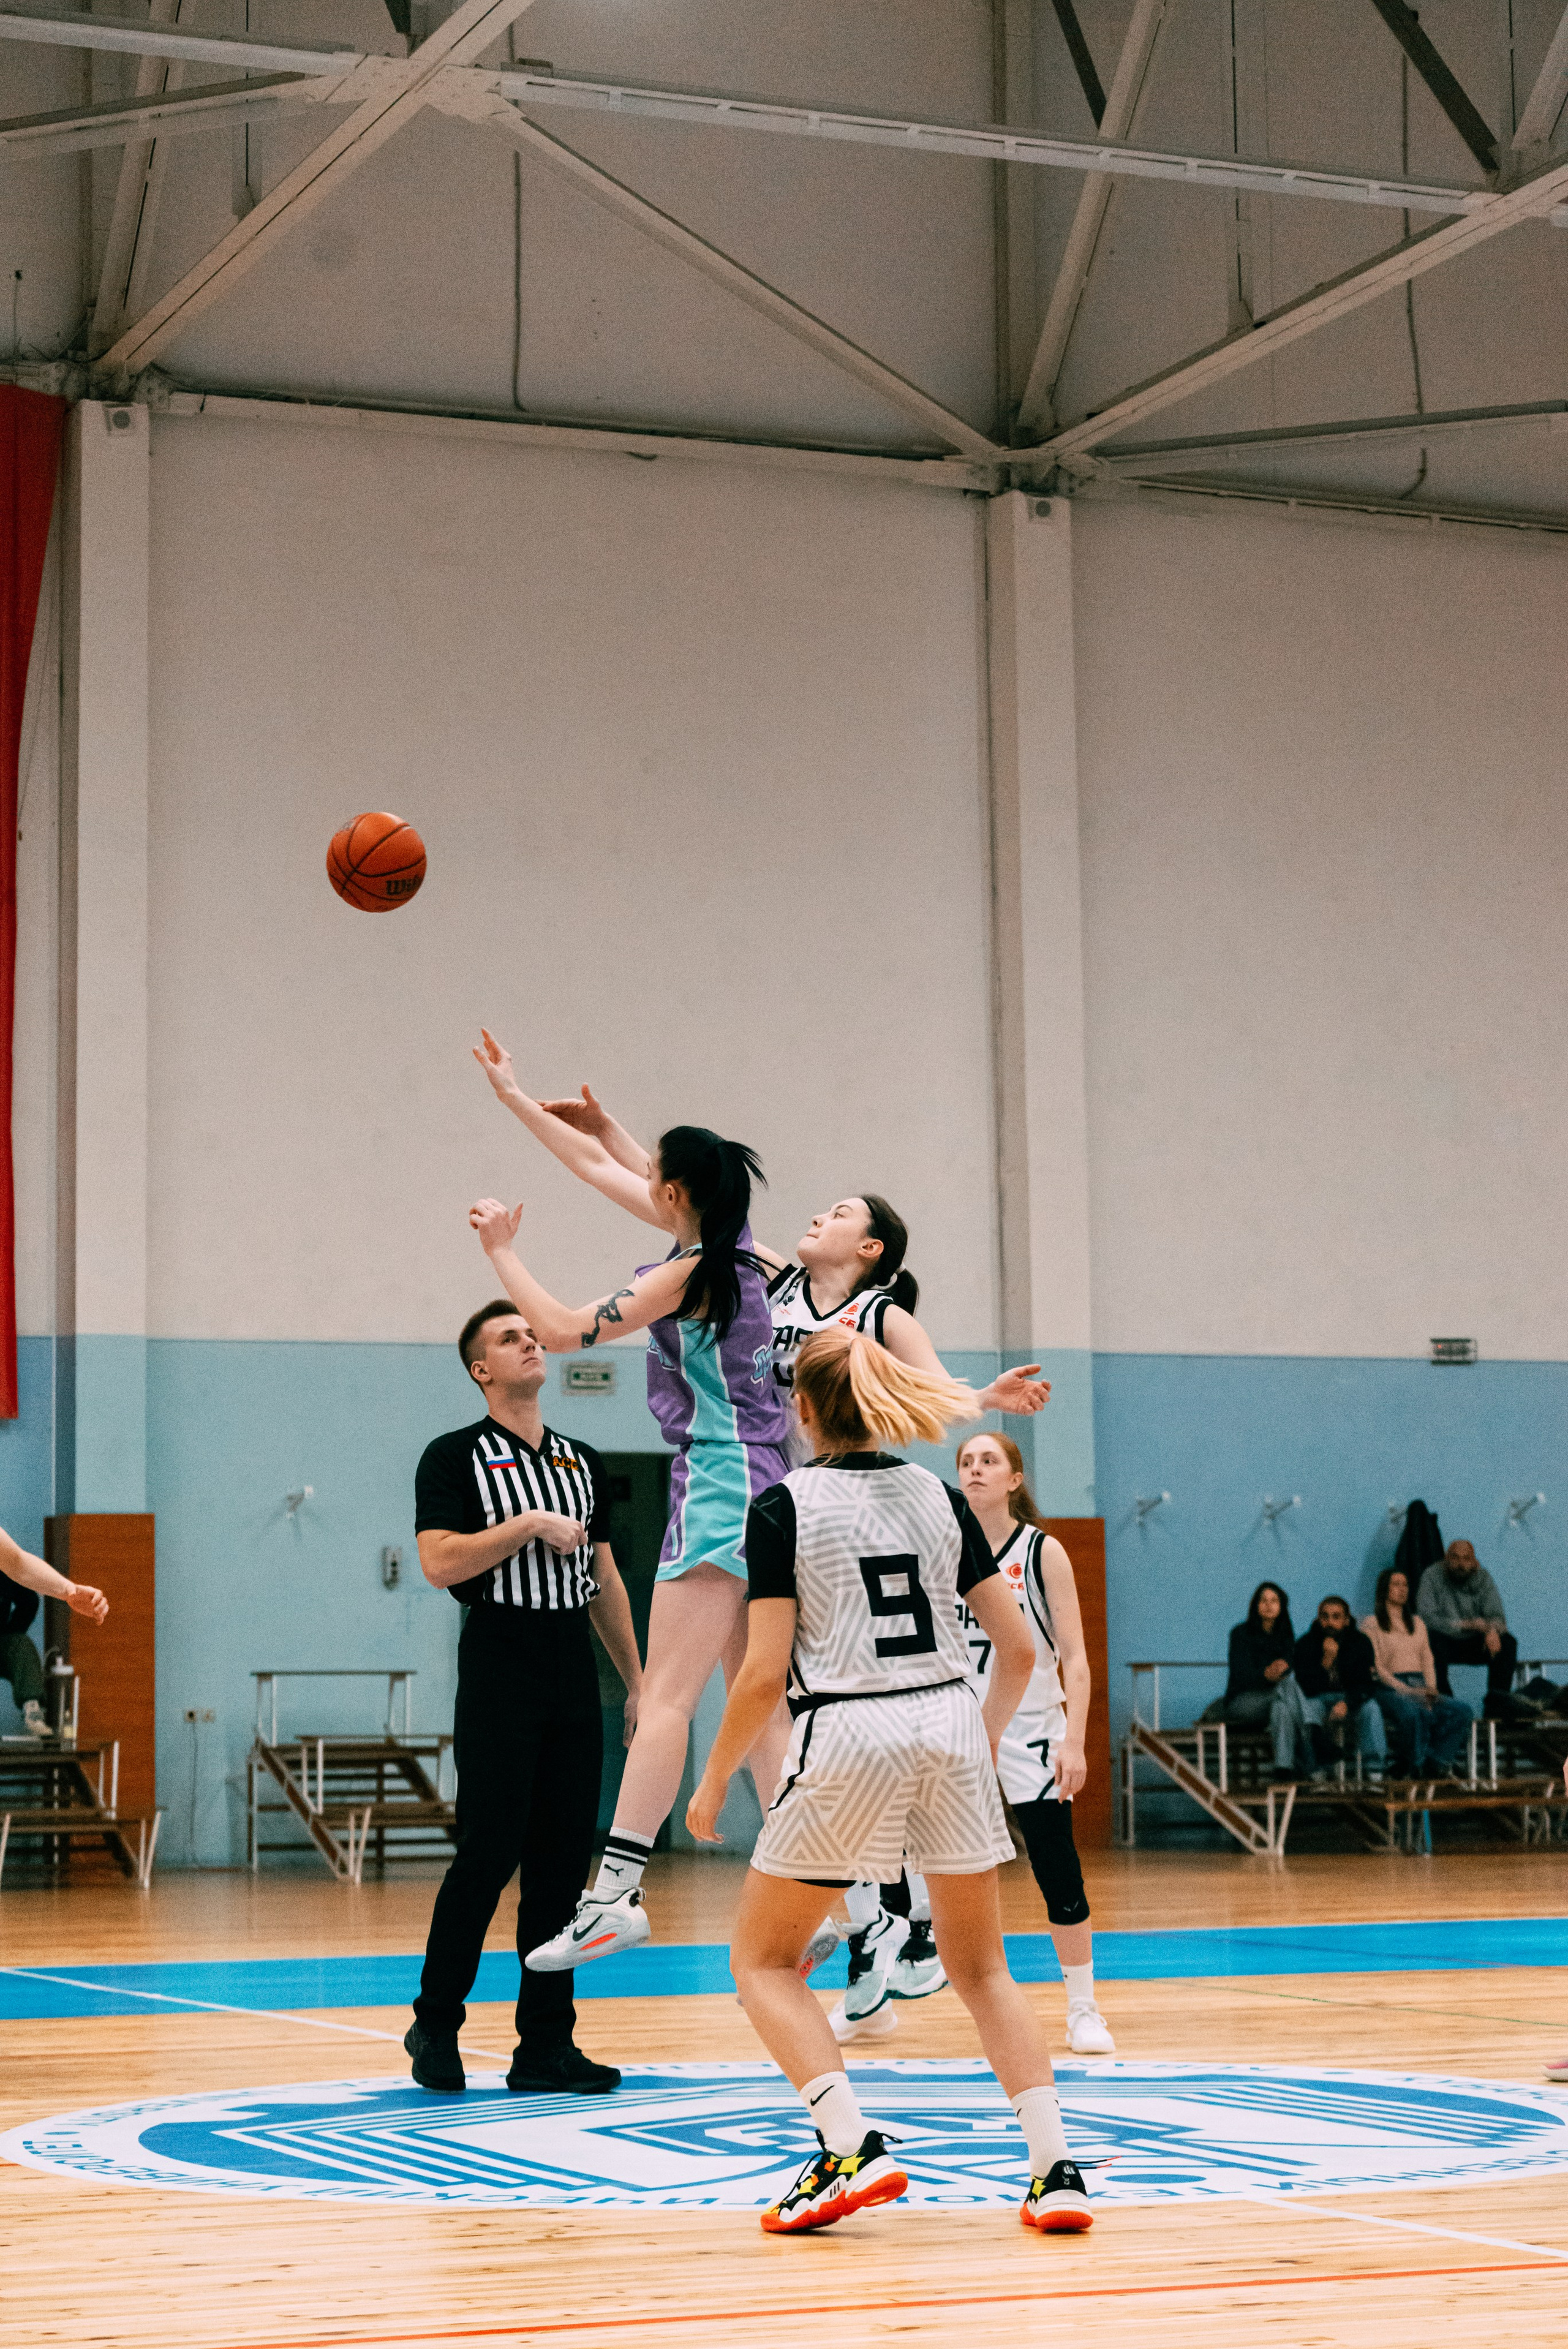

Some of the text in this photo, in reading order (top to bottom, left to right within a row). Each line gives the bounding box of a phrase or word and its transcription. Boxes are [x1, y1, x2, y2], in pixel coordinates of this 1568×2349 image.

[859, 1553, 938, 1658] 9
[969, 1640, 992, 1675] 7
[1027, 1739, 1049, 1768] 7
